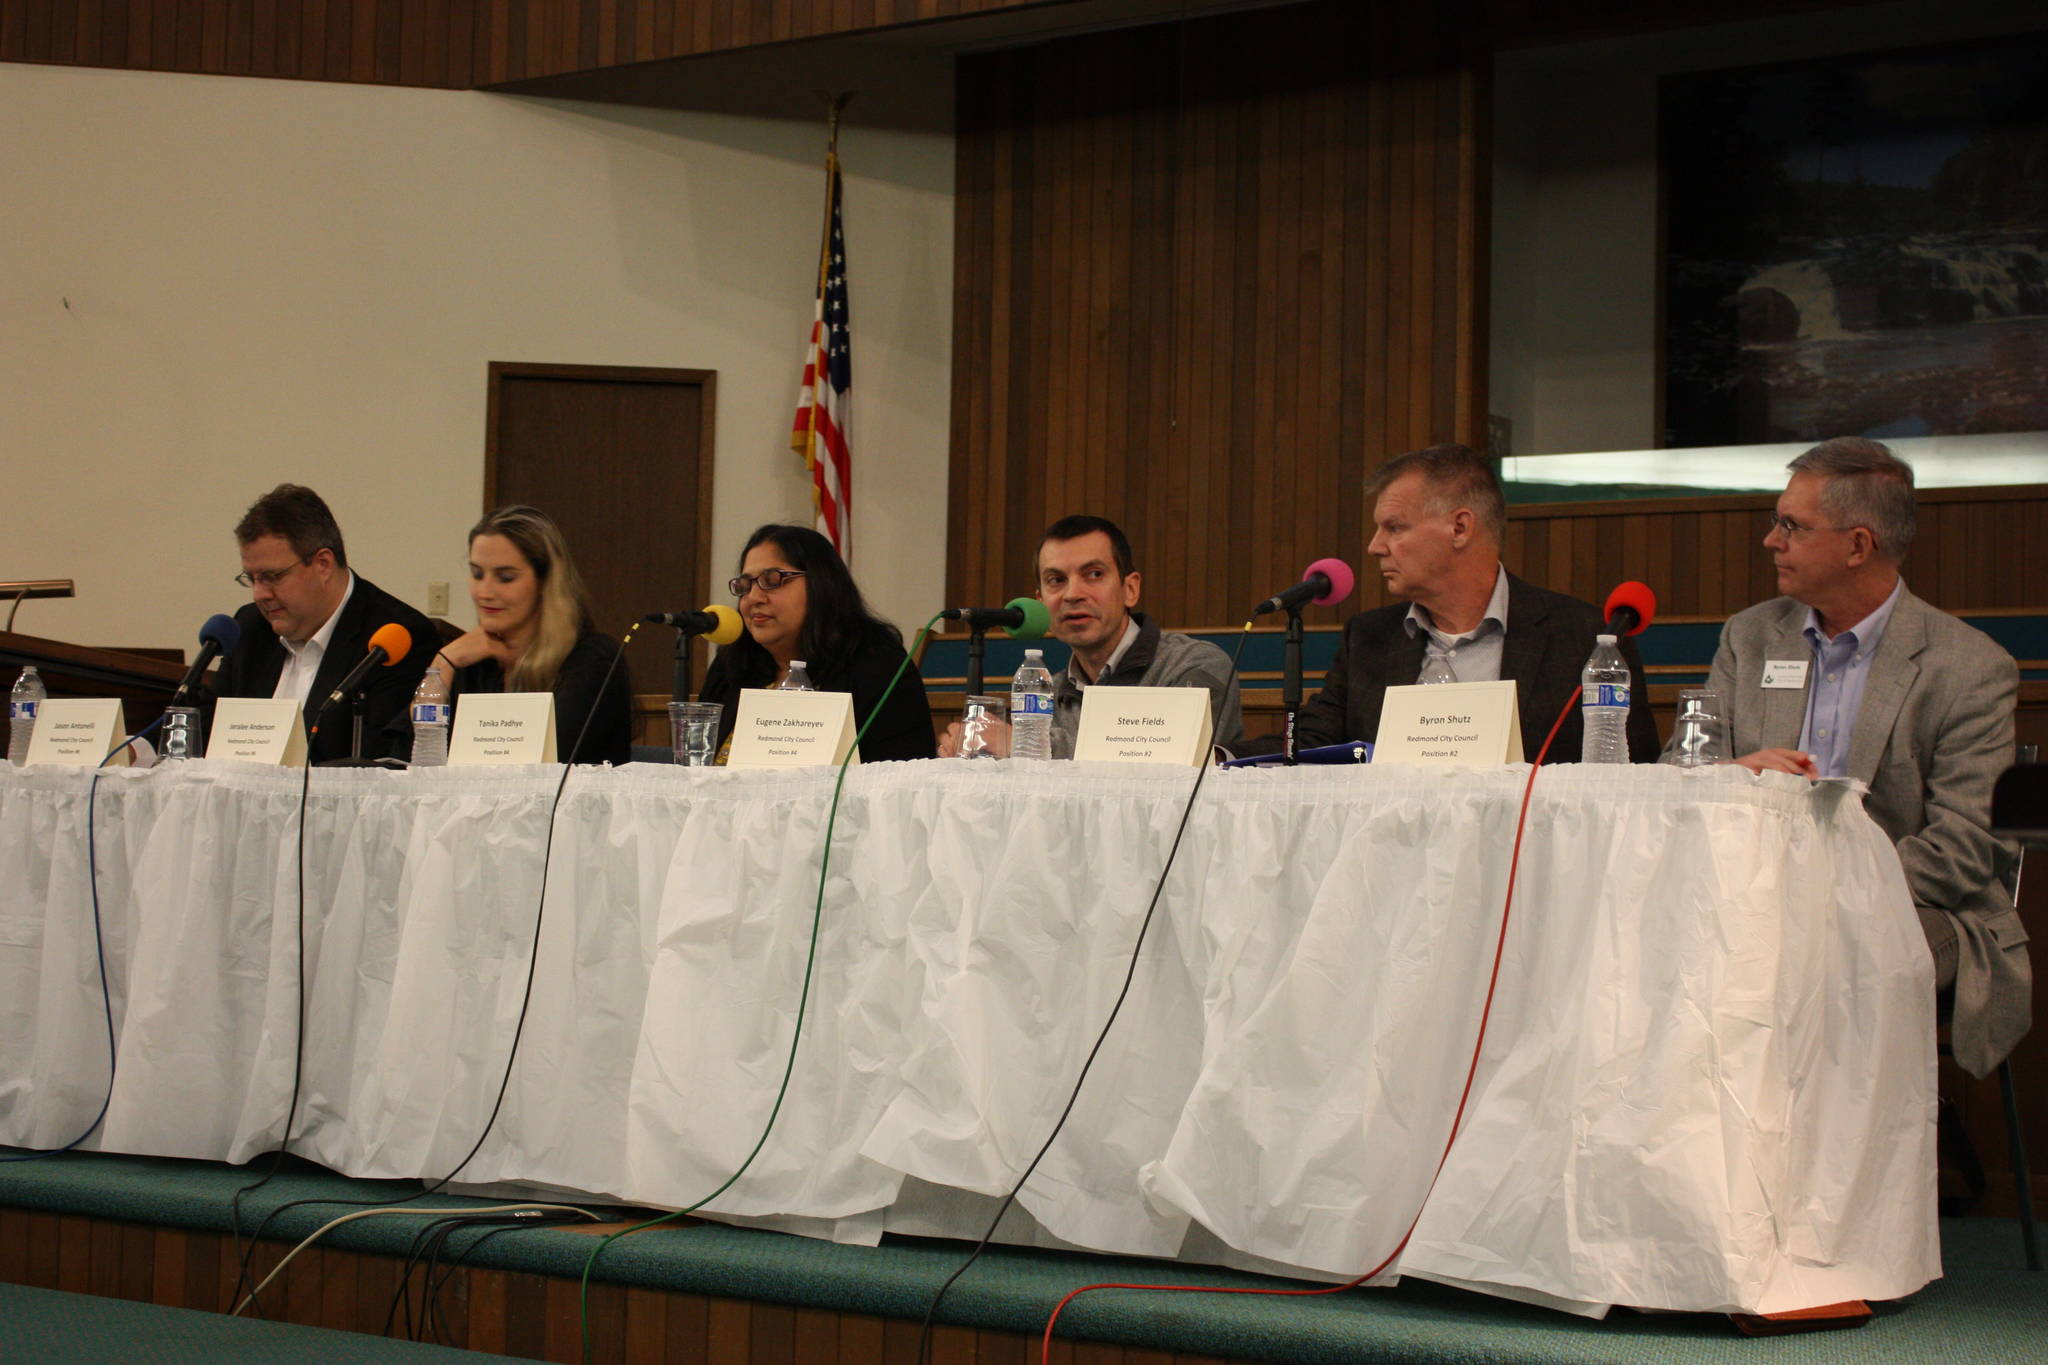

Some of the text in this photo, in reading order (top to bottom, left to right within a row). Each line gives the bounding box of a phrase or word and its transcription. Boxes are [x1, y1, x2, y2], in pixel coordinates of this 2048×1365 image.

[500, 719, 523, 728] Padhye
[755, 717, 824, 728] Eugene Zakhareyev
[1117, 717, 1165, 726] Steve Fields
[1419, 715, 1471, 726] Byron Shutz
[1105, 735, 1135, 743] Redmond
[1148, 735, 1171, 743] Council
[1406, 735, 1438, 743] Redmond
